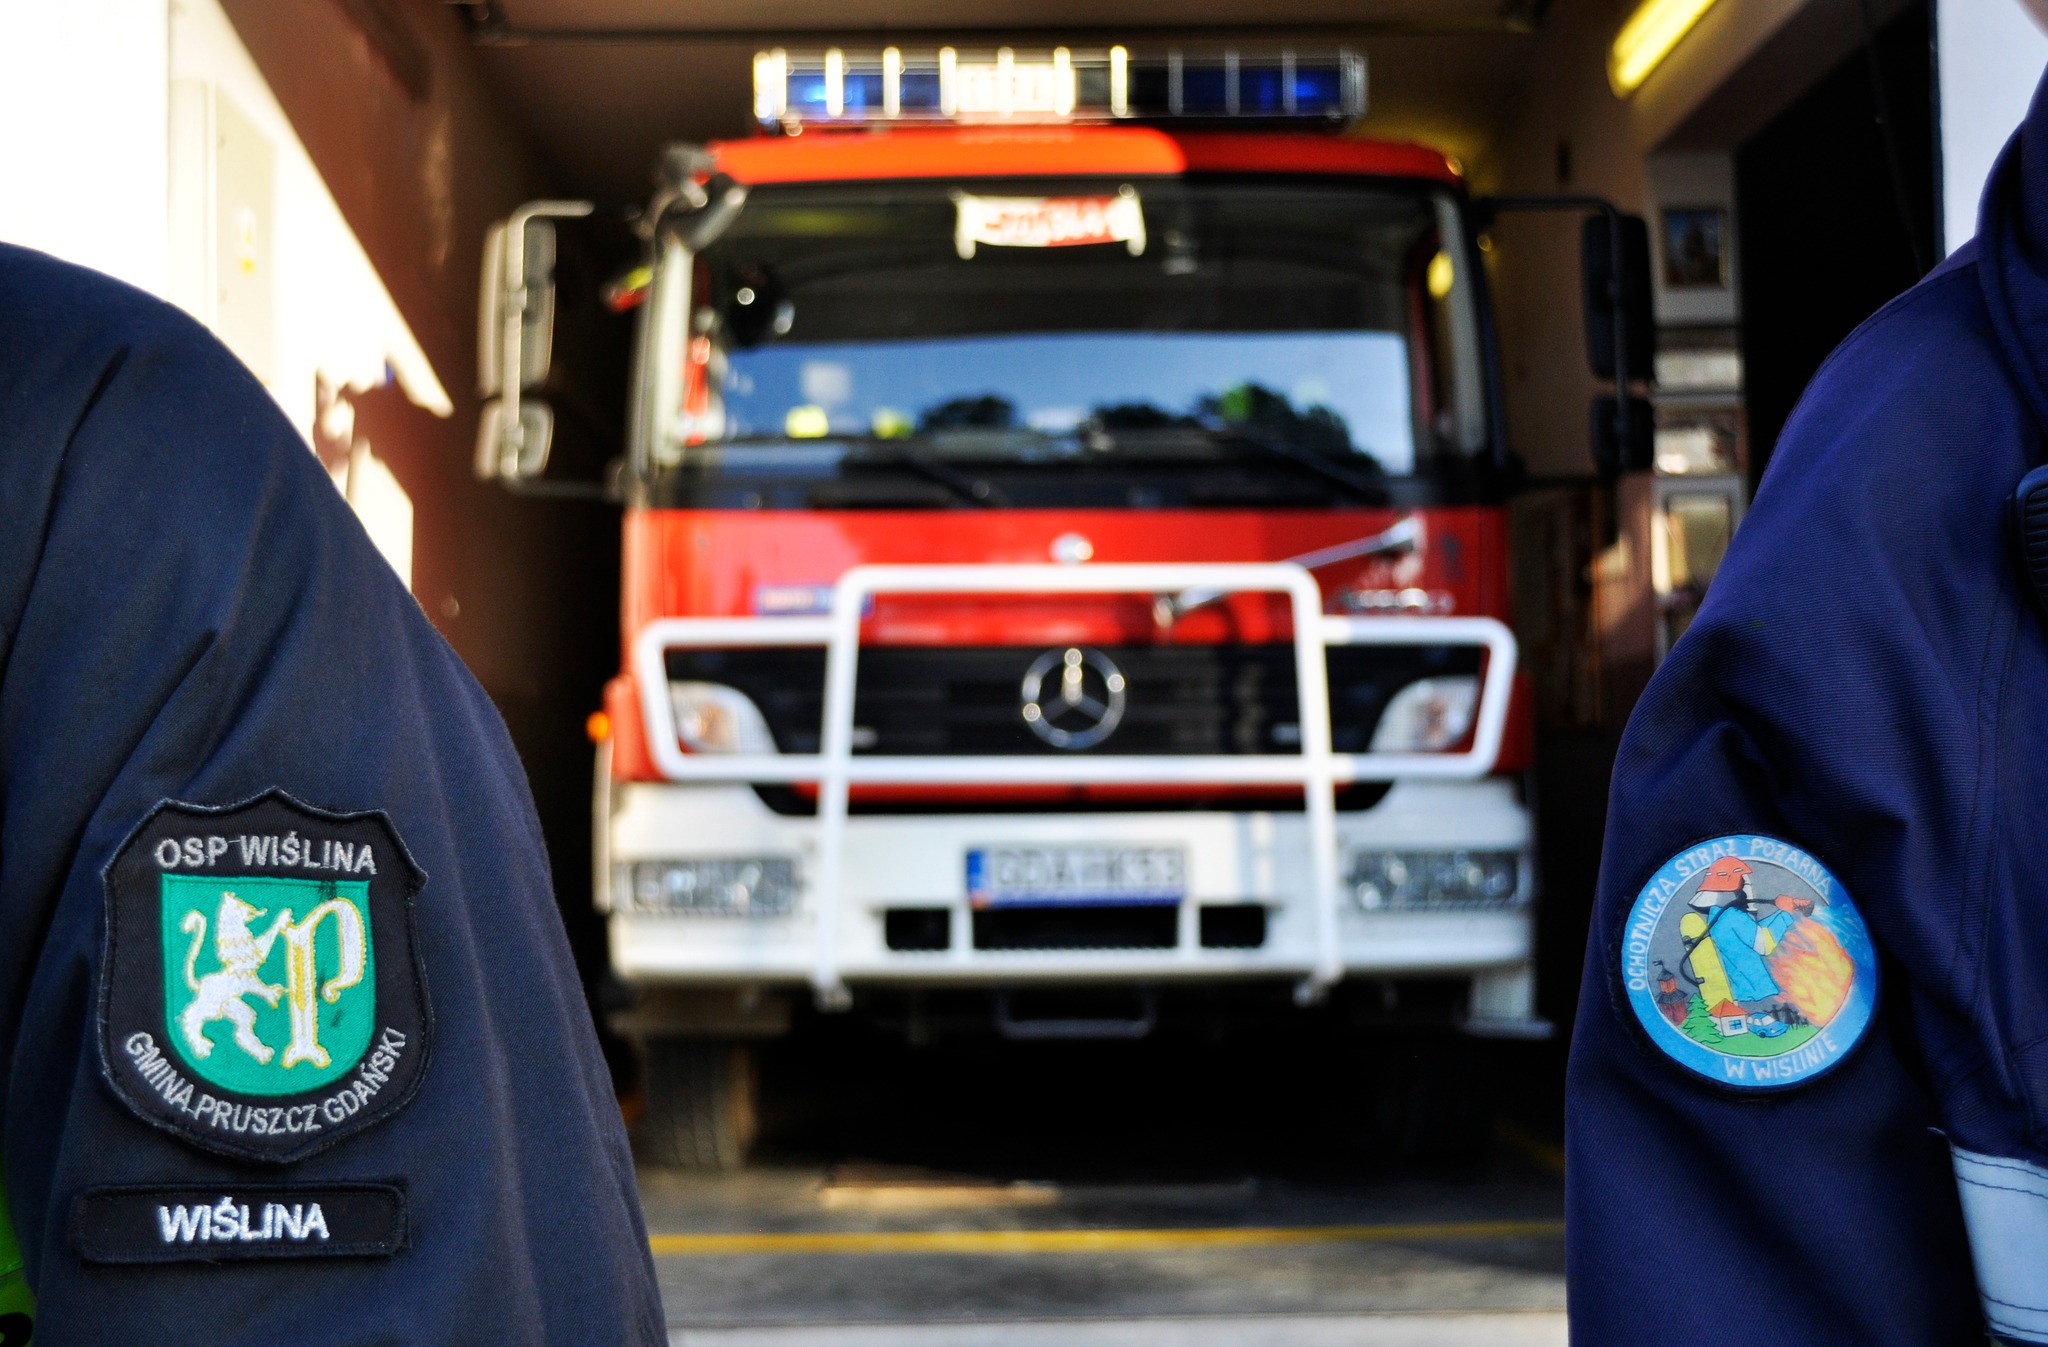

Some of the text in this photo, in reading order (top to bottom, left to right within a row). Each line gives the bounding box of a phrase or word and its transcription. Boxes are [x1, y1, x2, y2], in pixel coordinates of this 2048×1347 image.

[156, 832, 377, 875] OSP WIŚLINA
[1629, 878, 1676, 990] OCHOTNICZA
[125, 1028, 407, 1135] GMINA PRUSZCZ GDAŃSKI
[1724, 1057, 1745, 1080] W
[158, 1197, 329, 1244] WIŚLINA
